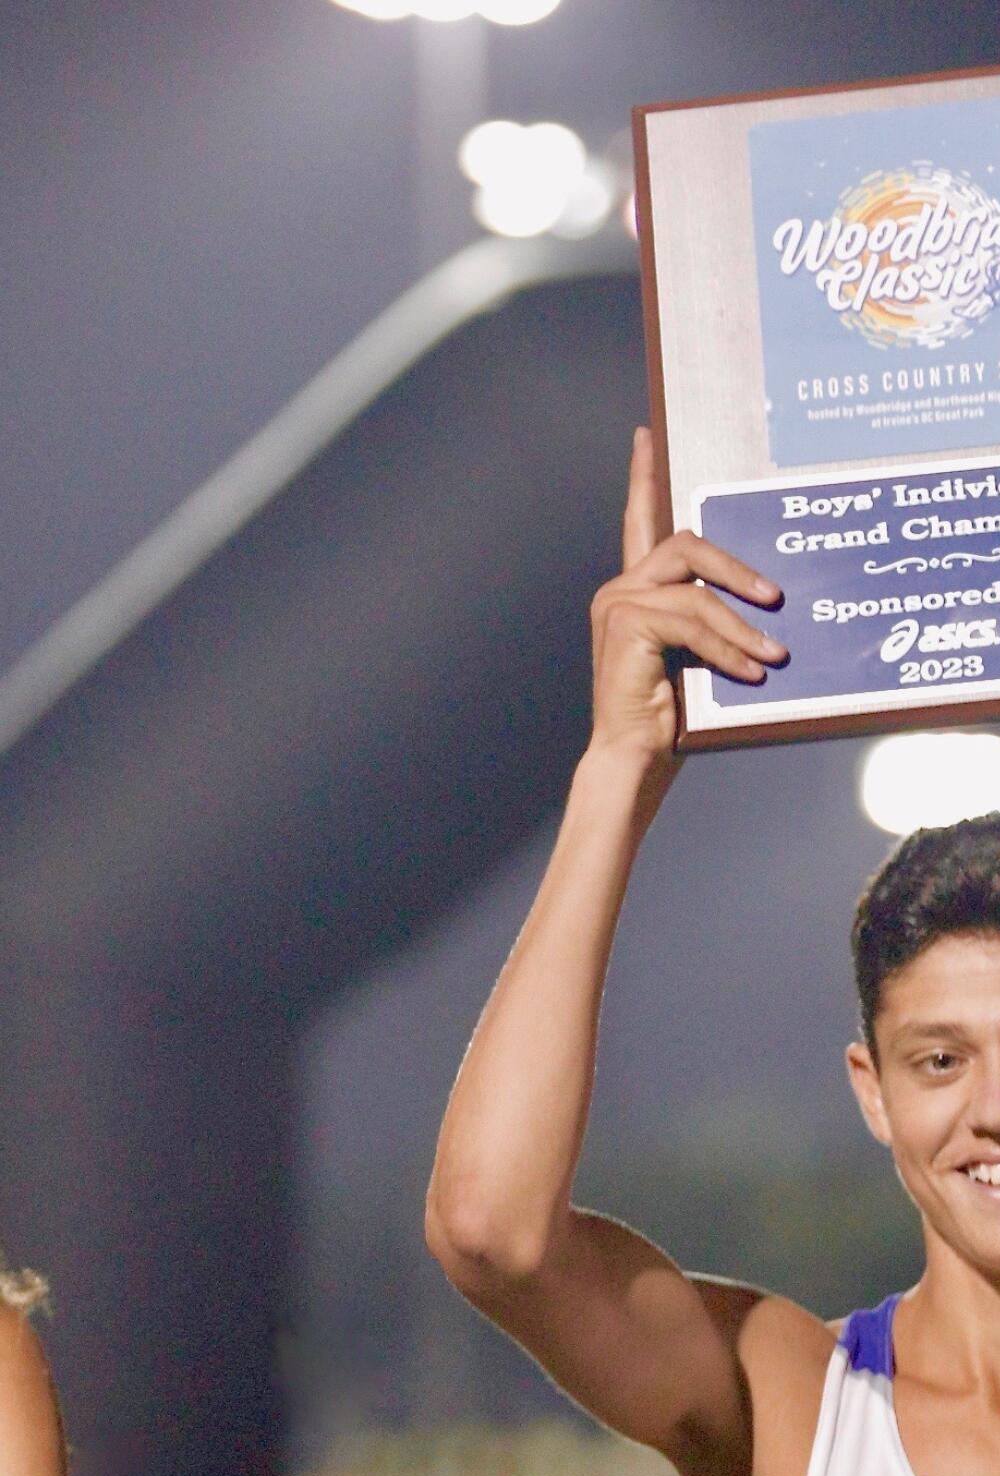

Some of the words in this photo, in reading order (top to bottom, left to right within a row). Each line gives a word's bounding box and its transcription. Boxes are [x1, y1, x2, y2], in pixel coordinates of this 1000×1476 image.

[816, 250, 981, 311] Classic
[797, 374, 870, 401] CROSS
[882, 362, 985, 392] COUNTRY
[807, 407, 840, 421] hosted
[841, 406, 854, 419] by
[856, 400, 912, 417] Woodbridge
[914, 396, 932, 411] and
[933, 390, 986, 409] Northwood
[871, 415, 882, 429] at
[882, 412, 919, 428] Irvine's
[935, 410, 962, 423] Great
[962, 407, 985, 421] Park
[782, 487, 882, 520] Boys'
[775, 521, 891, 555] Grand
[899, 656, 985, 684] 2023
